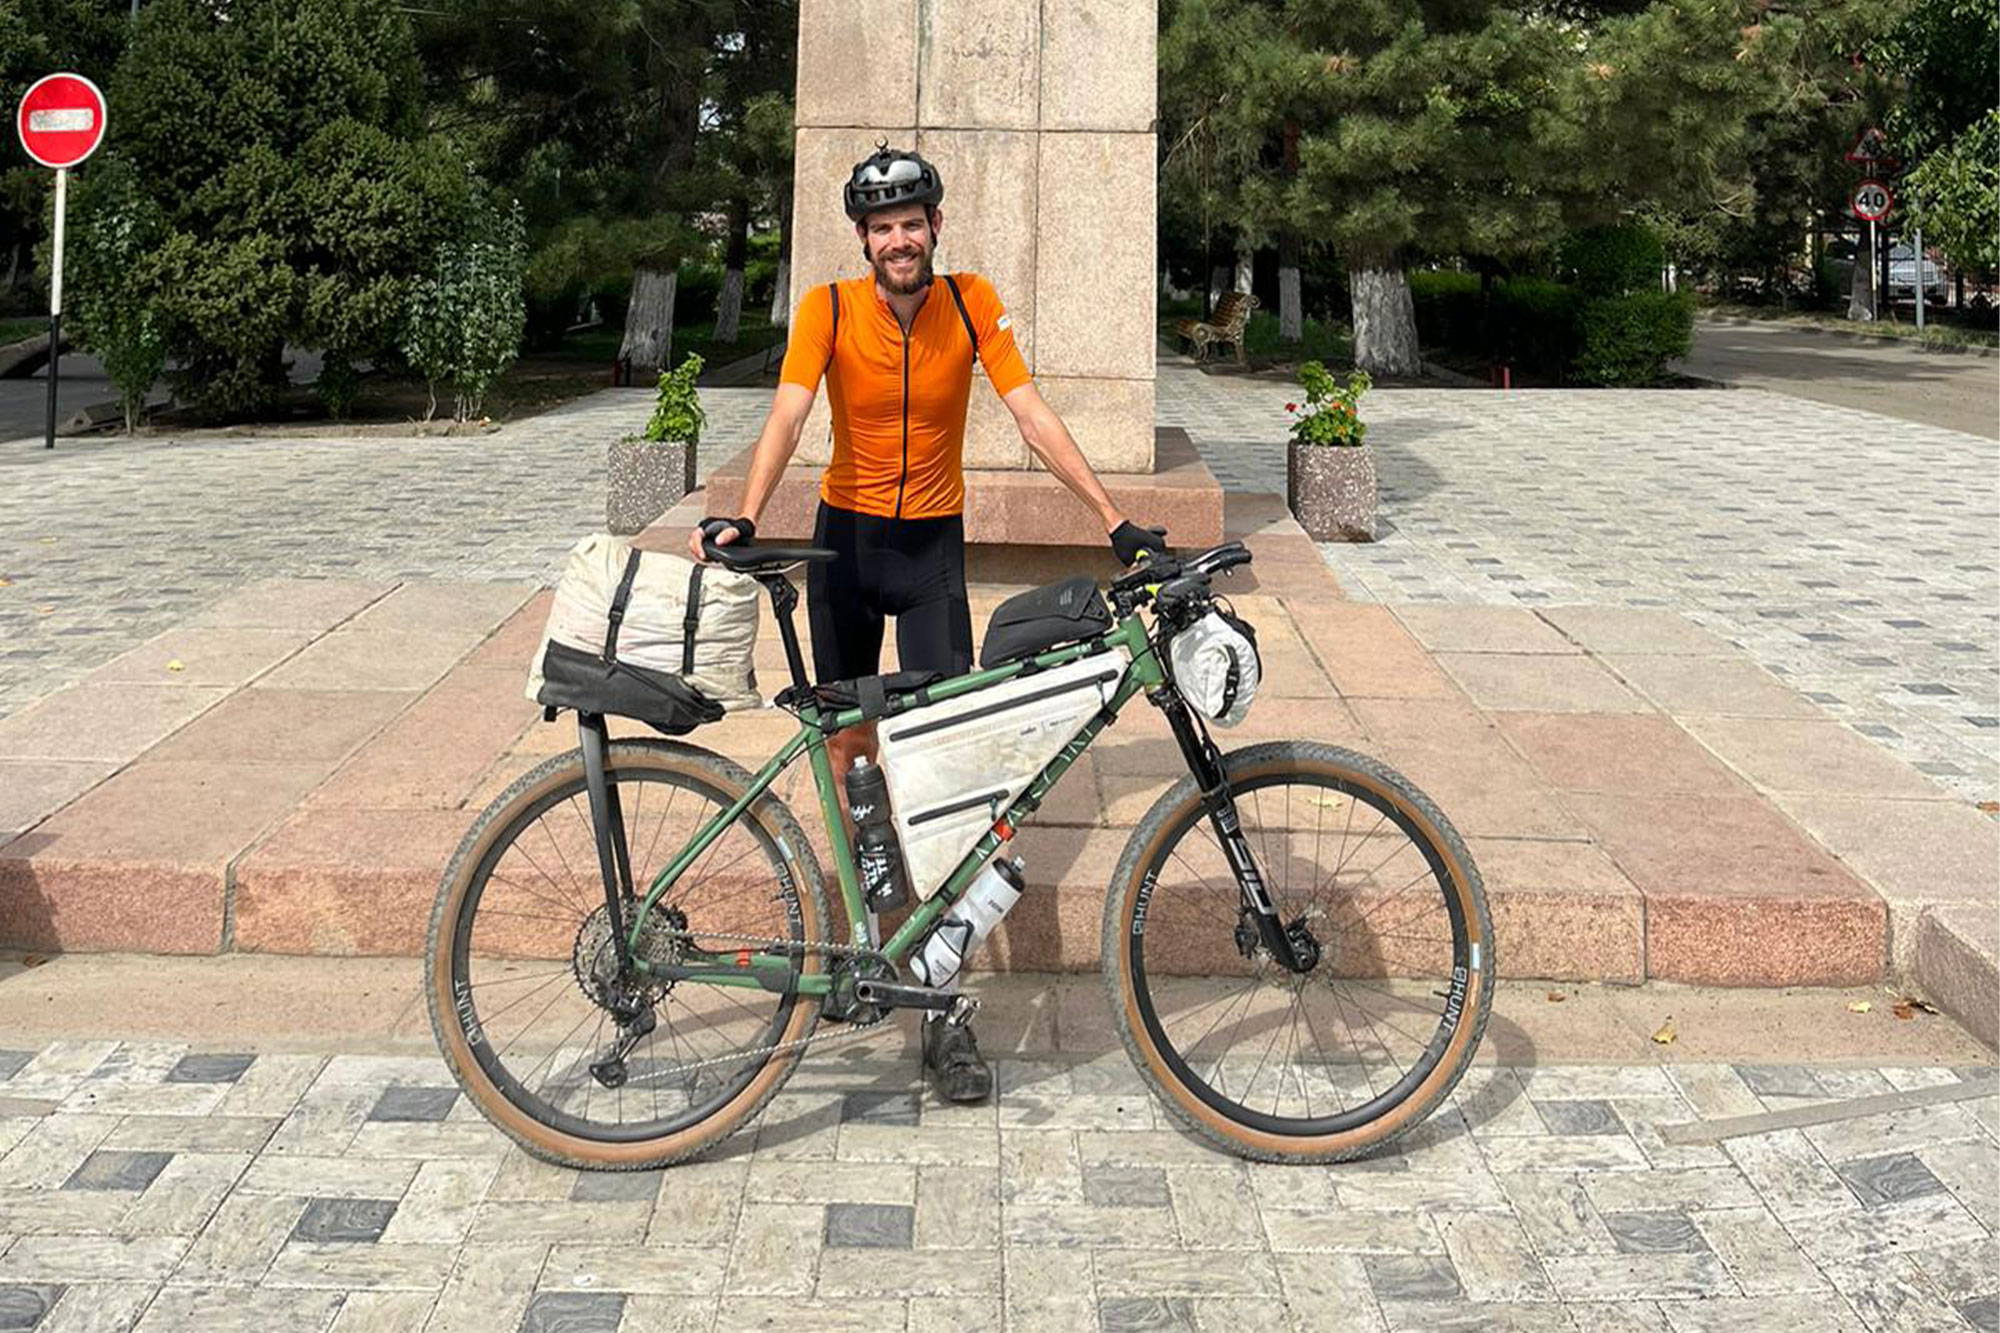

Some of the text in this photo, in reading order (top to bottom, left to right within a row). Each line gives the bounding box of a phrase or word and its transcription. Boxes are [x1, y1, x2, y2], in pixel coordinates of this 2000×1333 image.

[1859, 191, 1886, 208] 40
[1134, 868, 1158, 919] HUNT
[454, 979, 479, 1031] HUNT
[1442, 981, 1466, 1033] HUNT
